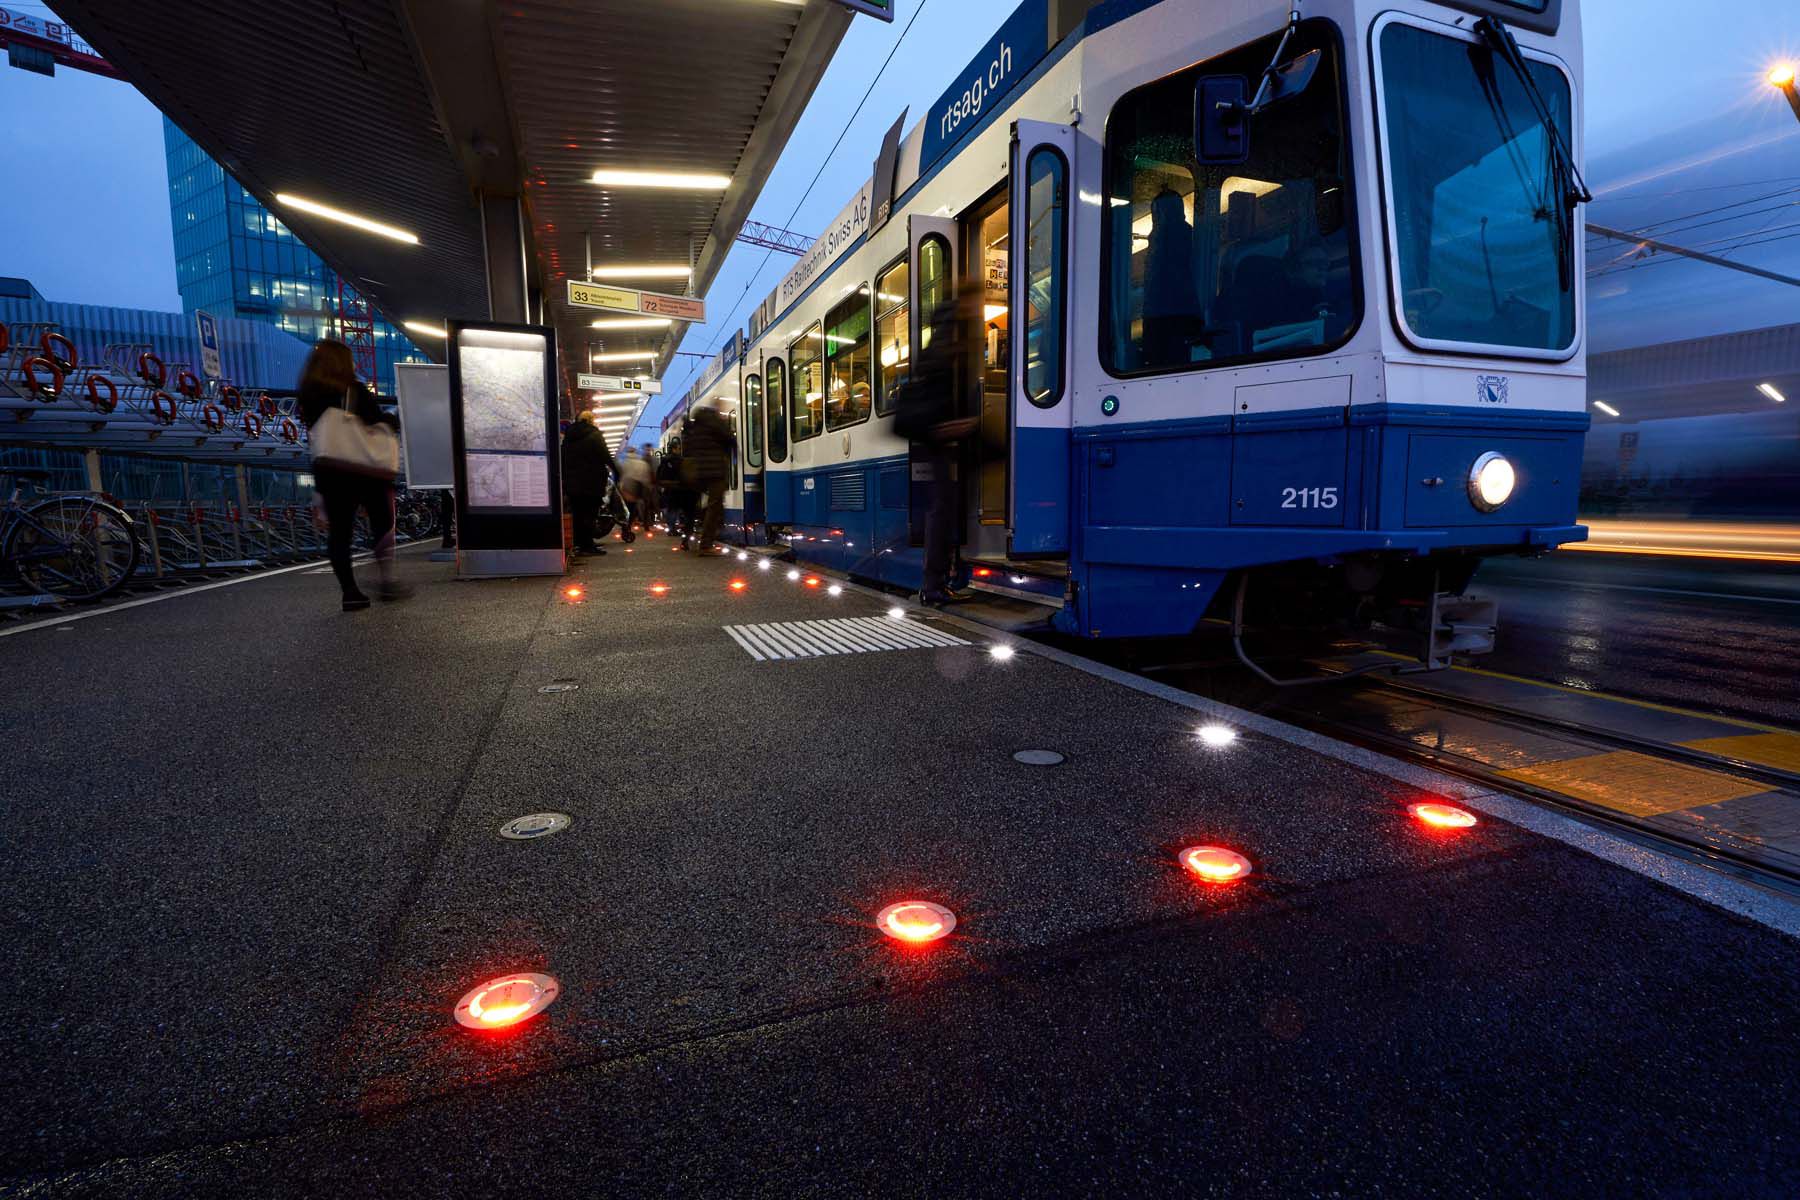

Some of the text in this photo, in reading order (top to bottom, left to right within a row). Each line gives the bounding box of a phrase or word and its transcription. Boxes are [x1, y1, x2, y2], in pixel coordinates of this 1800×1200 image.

[942, 42, 1011, 139] rtsag.ch
[878, 200, 889, 220] RTS
[783, 195, 867, 300] RTS Railtechnik Swiss AG
[574, 291, 588, 302] 33
[645, 301, 657, 311] 72
[1281, 487, 1338, 509] 2115
